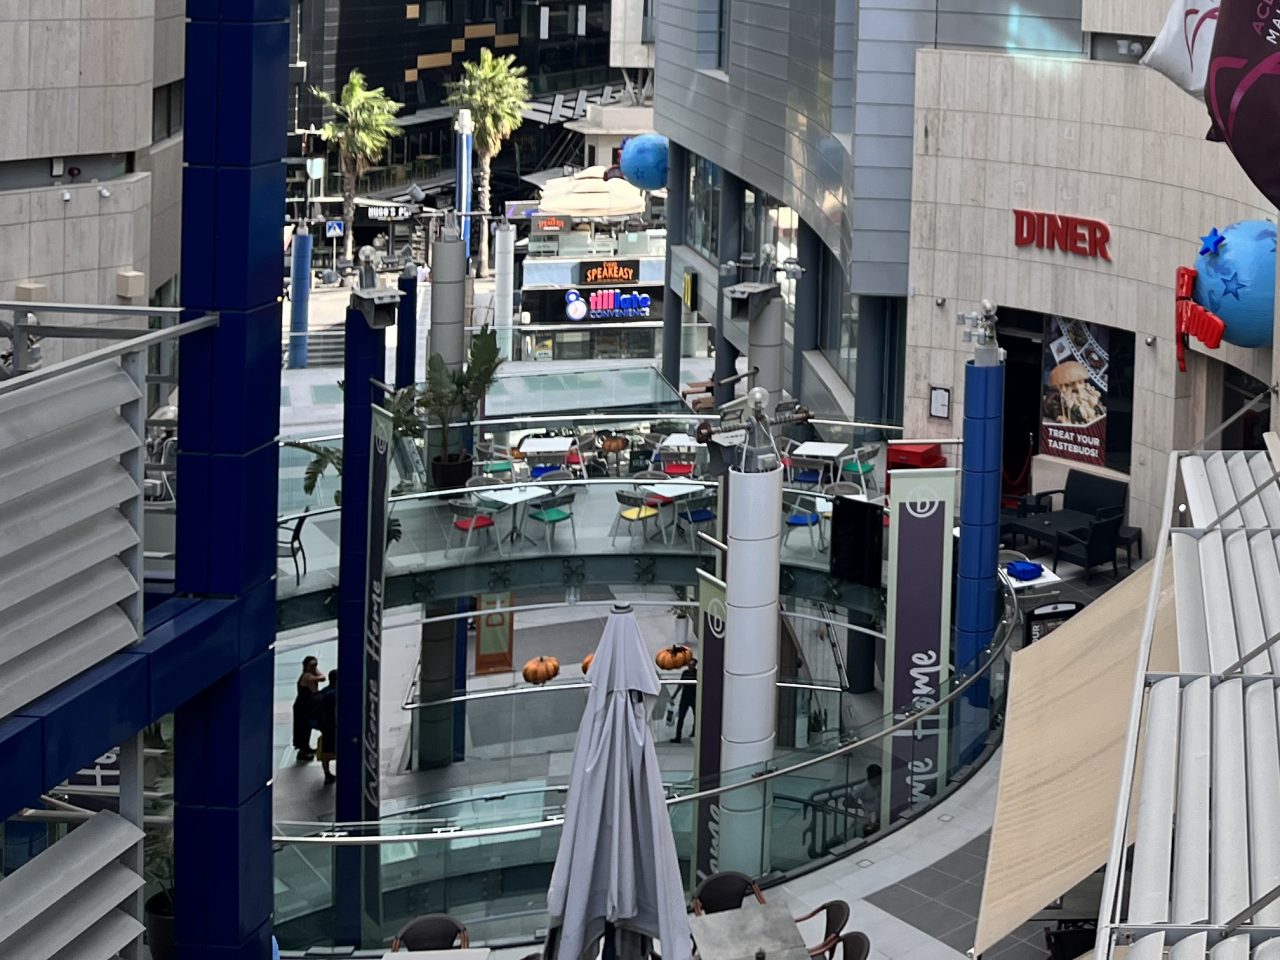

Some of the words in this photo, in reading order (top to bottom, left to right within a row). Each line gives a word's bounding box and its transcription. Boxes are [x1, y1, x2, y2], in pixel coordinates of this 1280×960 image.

[1012, 208, 1113, 263] DINER
[587, 265, 634, 282] SPEAKEASY
[590, 306, 651, 319] CONVENIENCE
[1047, 427, 1075, 441] TREAT
[1076, 433, 1100, 447] YOUR
[1047, 439, 1099, 458] TASTEBUDS!
[366, 579, 382, 663] Home
[364, 678, 379, 809] Welcome
